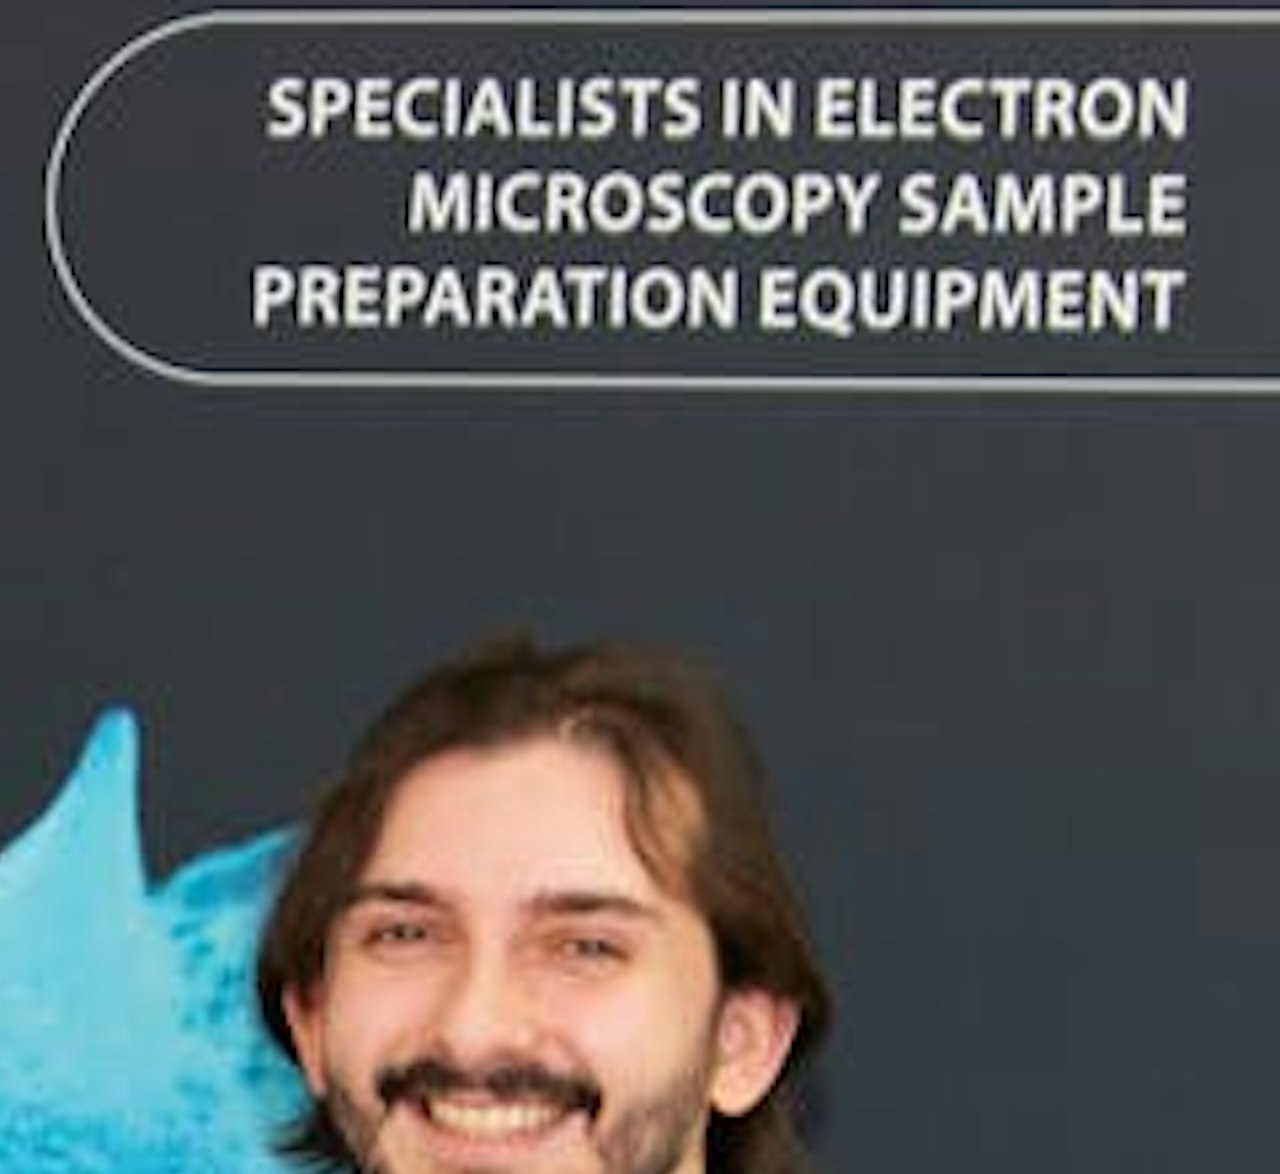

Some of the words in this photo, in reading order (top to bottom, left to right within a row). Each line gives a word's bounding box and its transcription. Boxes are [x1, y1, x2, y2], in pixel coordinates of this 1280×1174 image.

[267, 76, 702, 139] SPECIALISTS
[722, 77, 795, 139] IN
[816, 76, 1189, 139] ELECTRON
[408, 170, 881, 236] MICROSCOPY
[899, 171, 1188, 236] SAMPLE
[253, 265, 739, 331] PREPARATION
[759, 266, 1188, 338] EQUIPMENT
